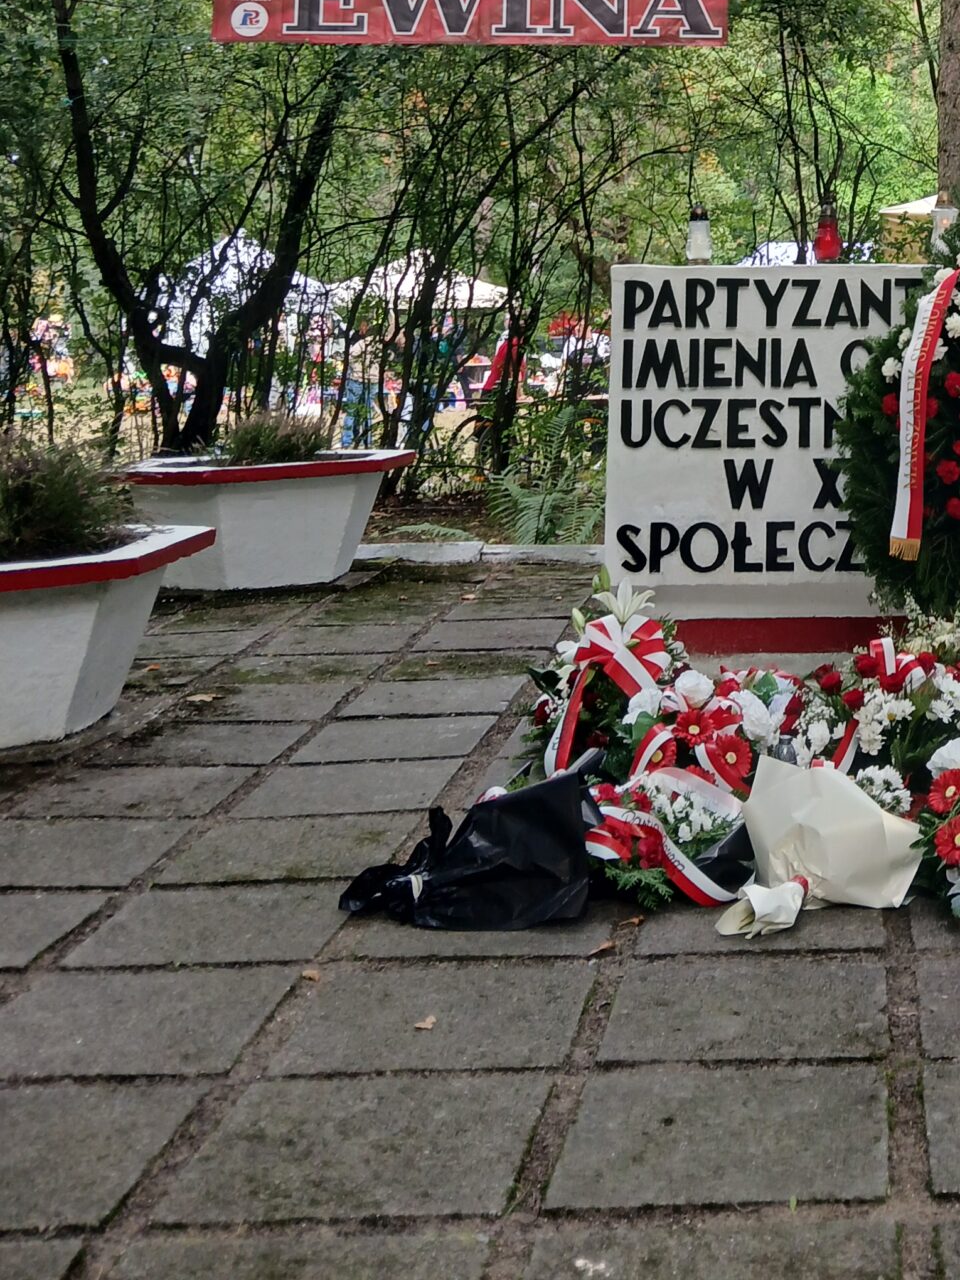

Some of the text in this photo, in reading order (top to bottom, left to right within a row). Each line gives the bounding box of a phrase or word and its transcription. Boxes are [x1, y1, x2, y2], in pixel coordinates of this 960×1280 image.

[623, 278, 923, 330] PARTYZANT
[622, 338, 818, 389] IMIENIA
[620, 398, 846, 449] UCZESTN
[723, 458, 774, 510] W
[616, 521, 868, 574] SPOŁECZ
